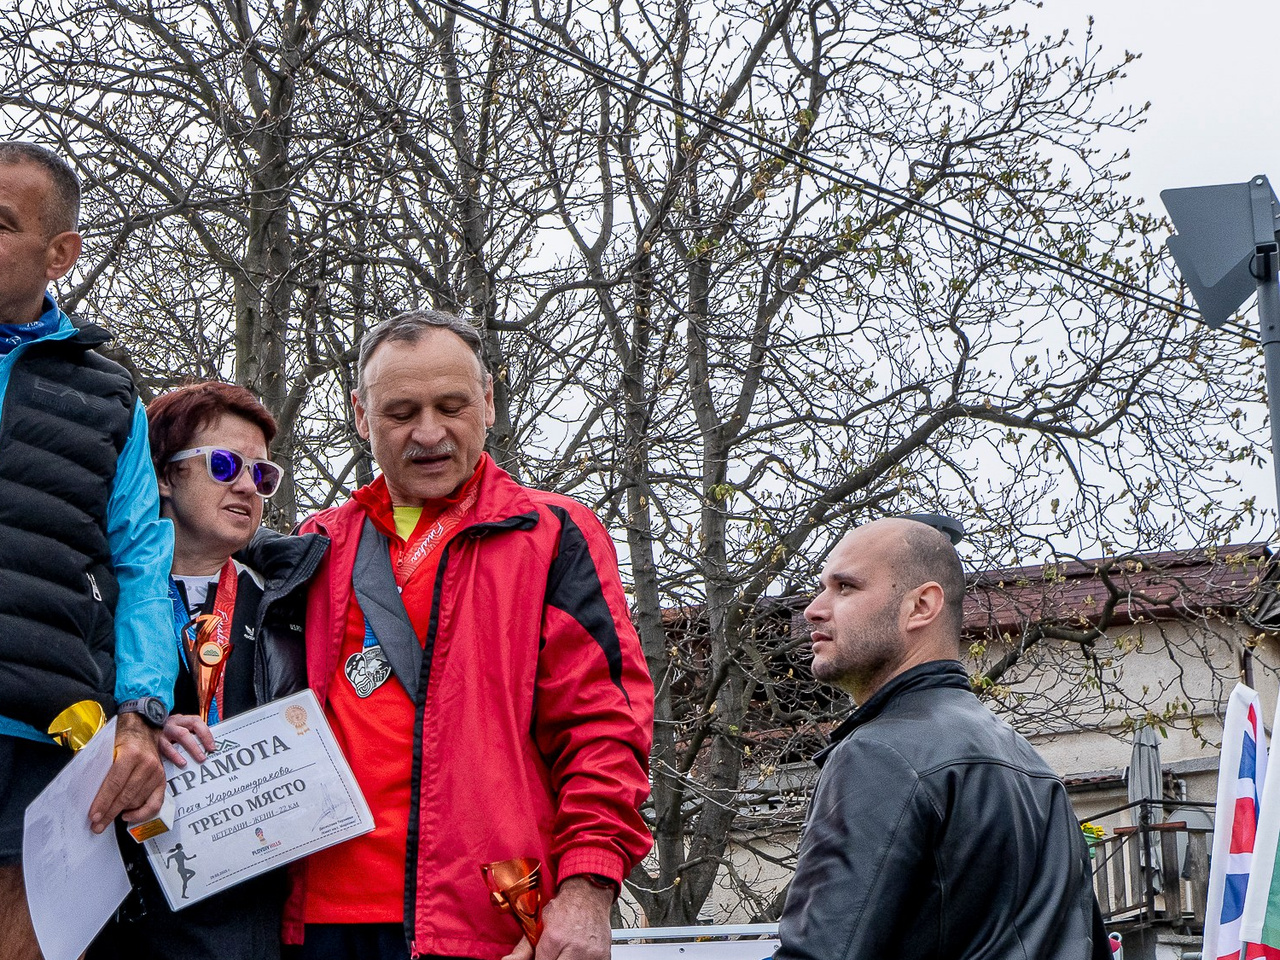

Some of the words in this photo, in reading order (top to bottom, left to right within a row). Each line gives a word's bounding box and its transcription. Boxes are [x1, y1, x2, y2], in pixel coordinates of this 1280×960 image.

[166, 735, 290, 798] ГРАМОТА
[228, 774, 238, 782] НА
[188, 804, 244, 836] ТРЕТО
[248, 778, 306, 812] МЯСТО
[211, 820, 248, 842] ВЕТЕРАНИ
[252, 811, 275, 828] ЖЕНИ
[279, 806, 287, 816] 22
